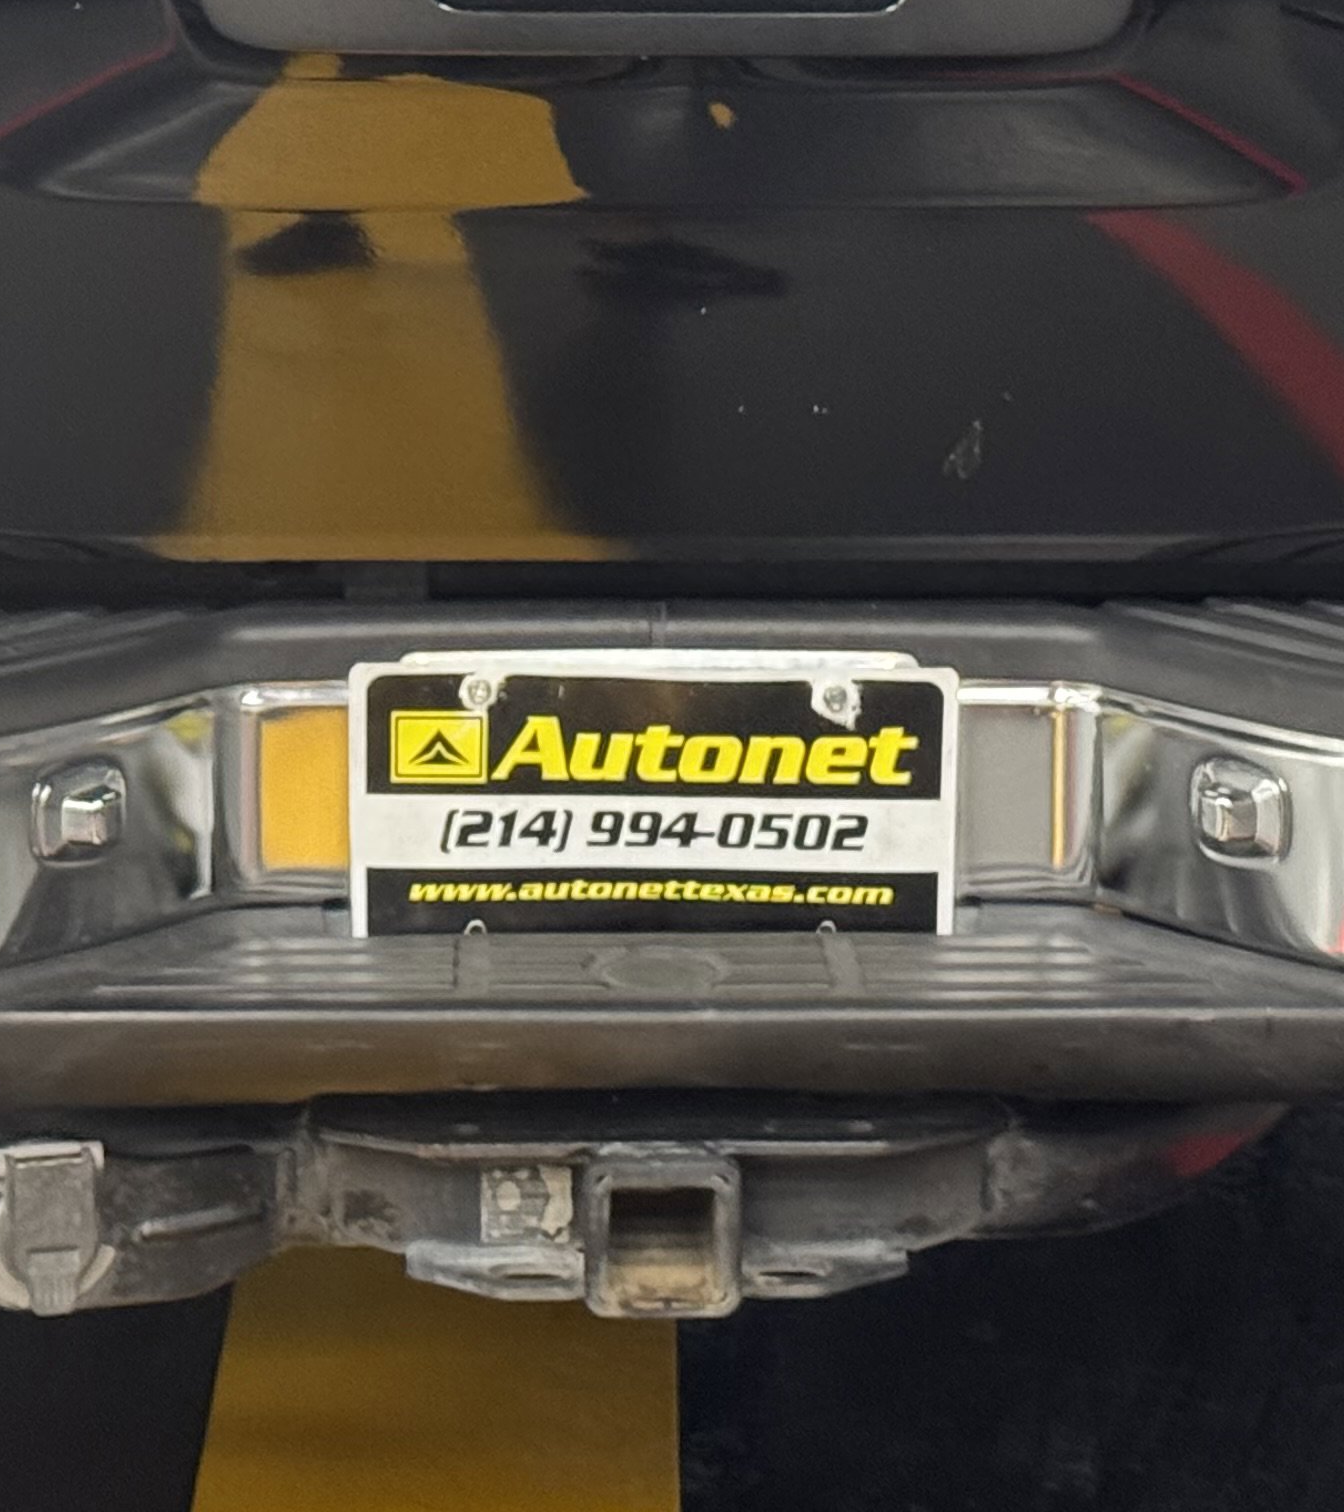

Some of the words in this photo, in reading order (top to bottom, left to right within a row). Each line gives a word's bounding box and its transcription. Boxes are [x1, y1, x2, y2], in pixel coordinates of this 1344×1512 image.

[490, 715, 919, 786] Autonet
[439, 808, 573, 853] (214)
[586, 809, 869, 852] 994-0502
[408, 878, 895, 907] www.autonettexas.com
